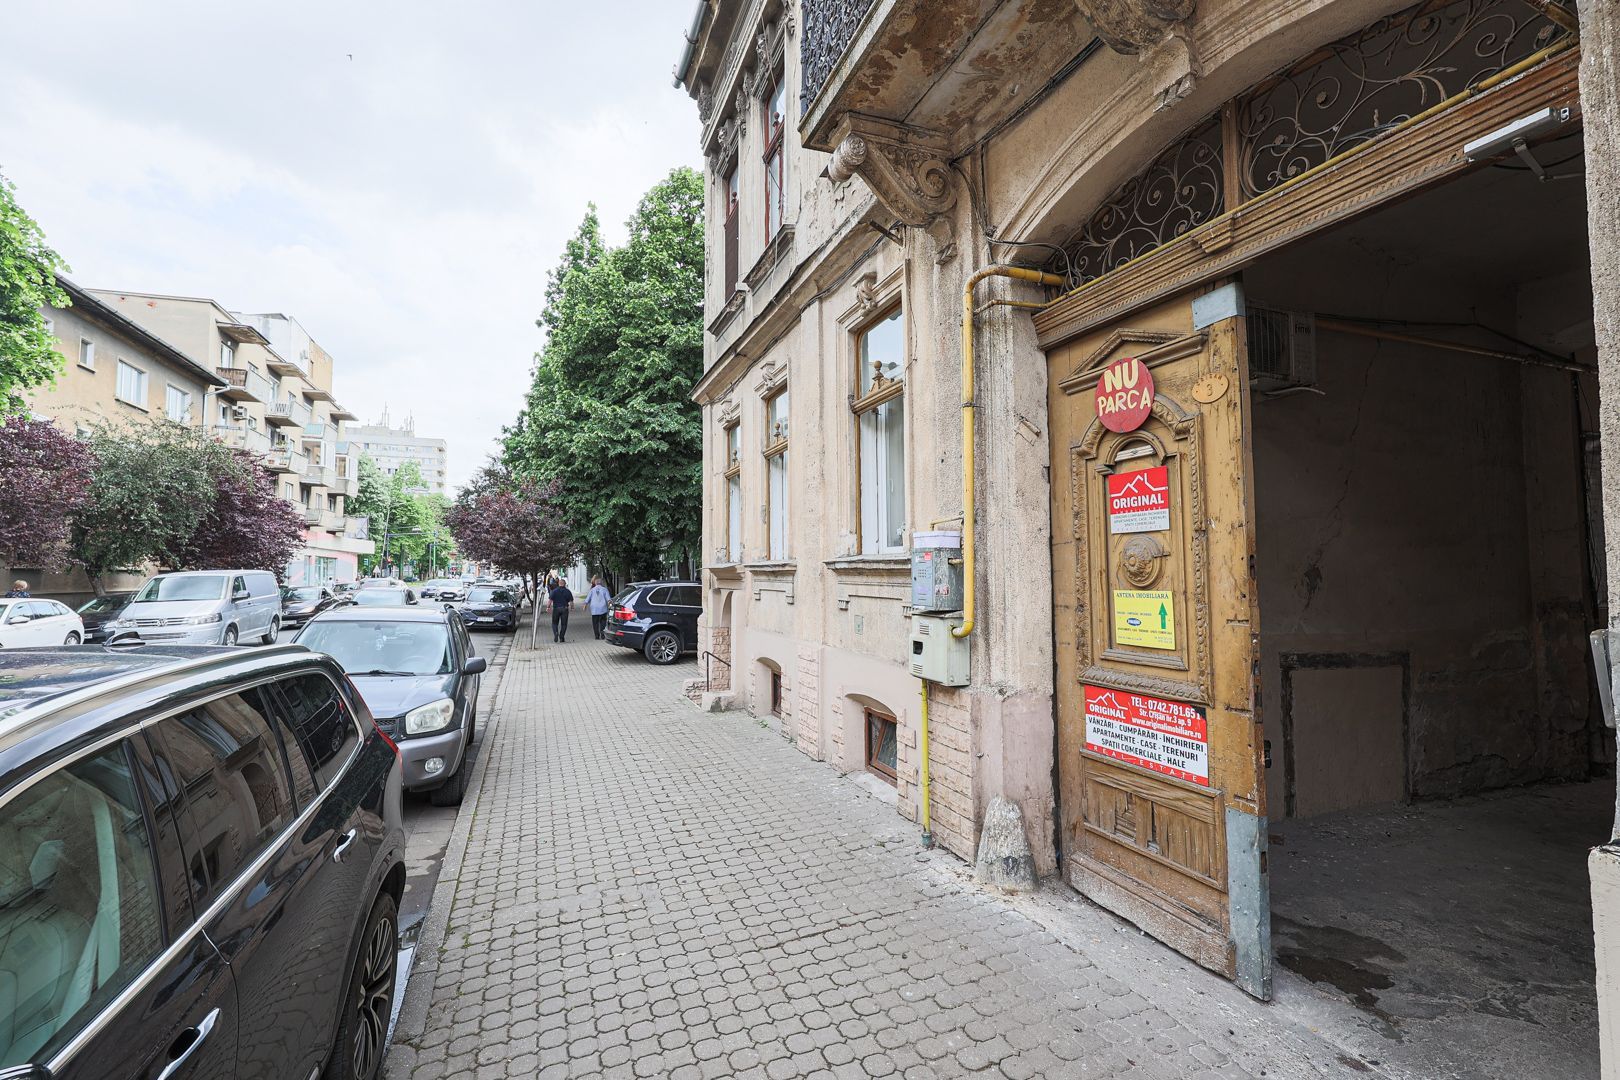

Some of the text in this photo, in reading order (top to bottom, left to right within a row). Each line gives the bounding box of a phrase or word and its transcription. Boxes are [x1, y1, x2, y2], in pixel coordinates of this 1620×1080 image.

[1104, 358, 1139, 393] NU
[1098, 387, 1151, 416] PARCA
[1206, 384, 1212, 396] 3
[1113, 493, 1164, 509] ORIGINAL
[1089, 704, 1126, 719] ORIGINAL
[1139, 708, 1148, 717] Str.
[1178, 718, 1186, 727] ap.
[1132, 717, 1201, 739] www.originalimobiliare.ro
[1093, 727, 1135, 744] APARTAMENTE
[1140, 740, 1157, 750] CASE
[1162, 745, 1198, 761] TERENURI
[1121, 743, 1162, 762] COMERCIALE
[1167, 757, 1186, 768] HALE
[1094, 746, 1197, 782] REAL ESTATE
